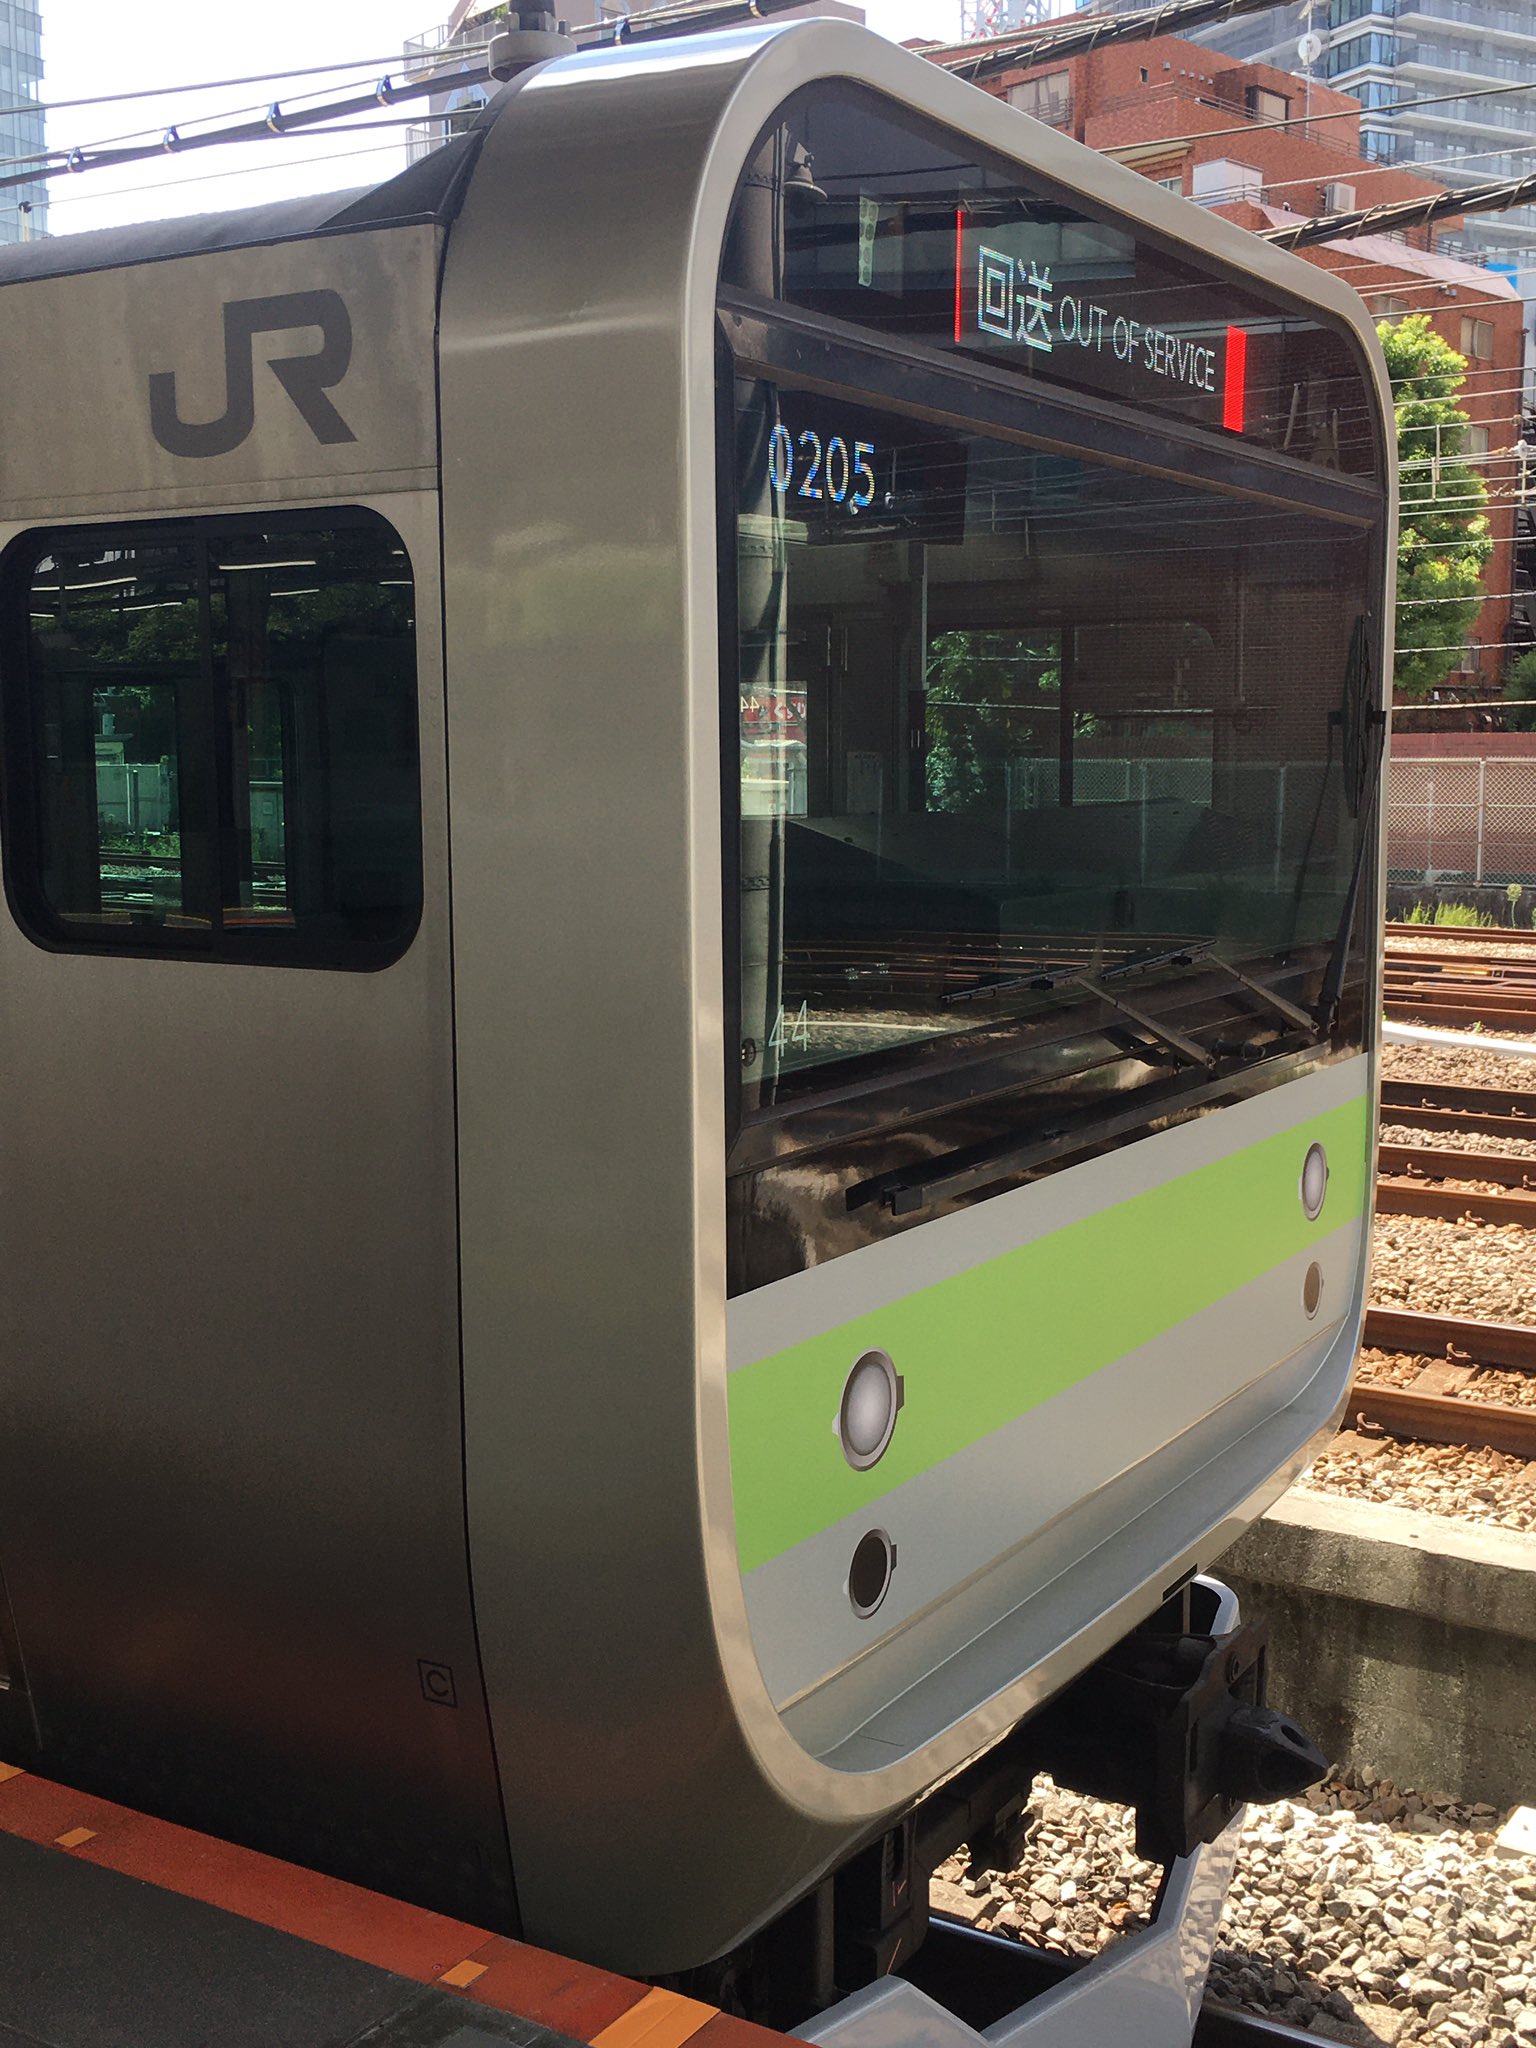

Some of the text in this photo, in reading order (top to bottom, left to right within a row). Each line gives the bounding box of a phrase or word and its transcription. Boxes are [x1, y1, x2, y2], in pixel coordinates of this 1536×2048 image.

[978, 245, 1053, 353] 回送
[1059, 295, 1216, 392] OUT OF SERVICE
[148, 288, 358, 459] JR
[768, 423, 876, 507] 0205
[768, 999, 811, 1057] 44
[426, 1669, 450, 1697] C
